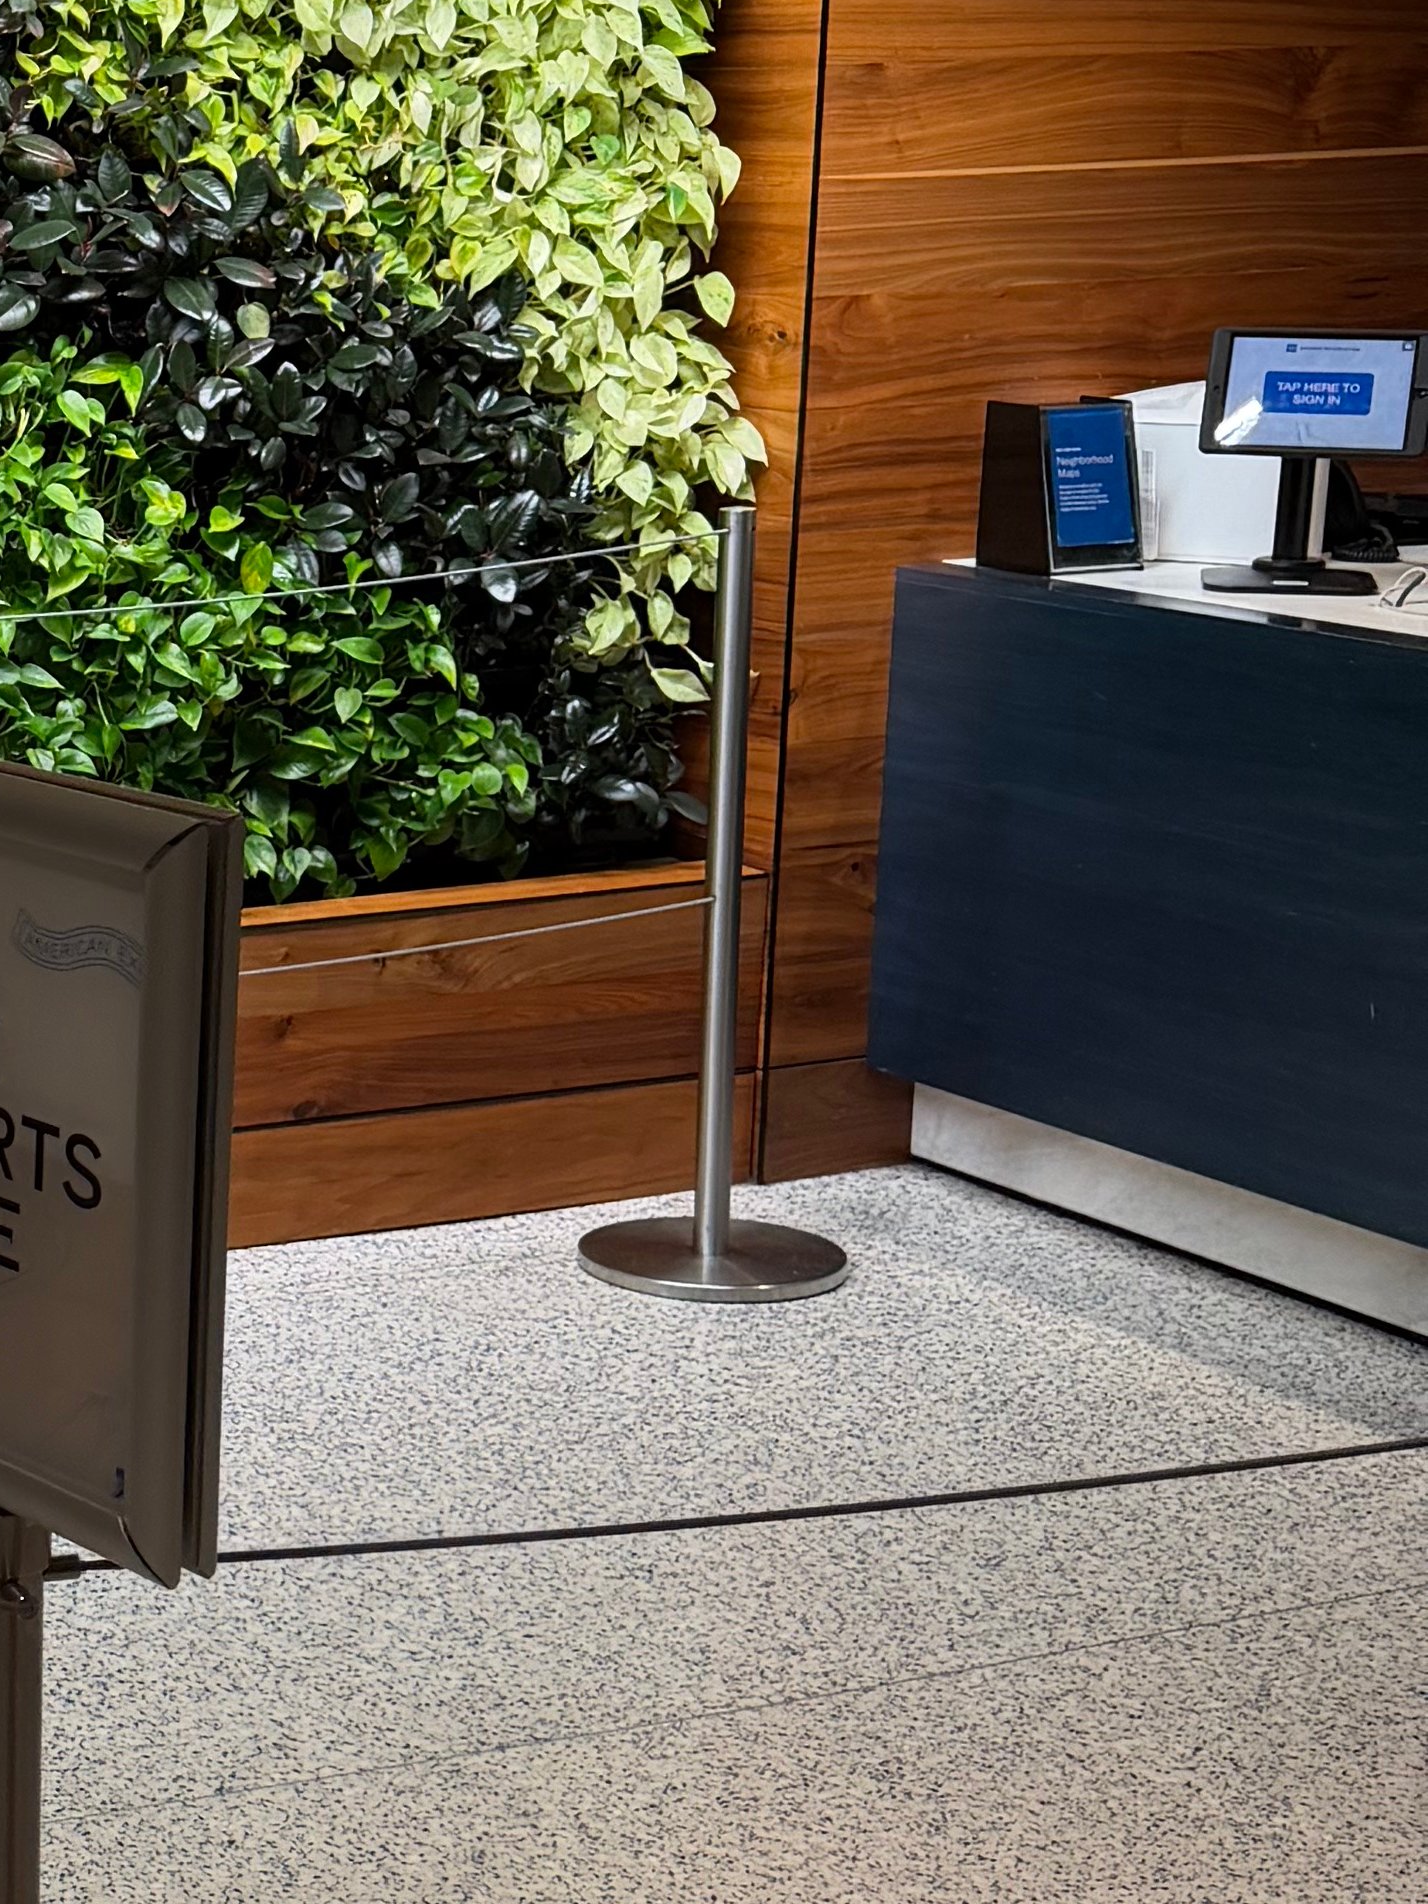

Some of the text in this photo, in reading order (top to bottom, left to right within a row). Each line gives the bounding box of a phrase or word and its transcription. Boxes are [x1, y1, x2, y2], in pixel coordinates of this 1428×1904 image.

[1277, 381, 1360, 393] TAP HERE TO
[1293, 394, 1341, 406] SIGN IN
